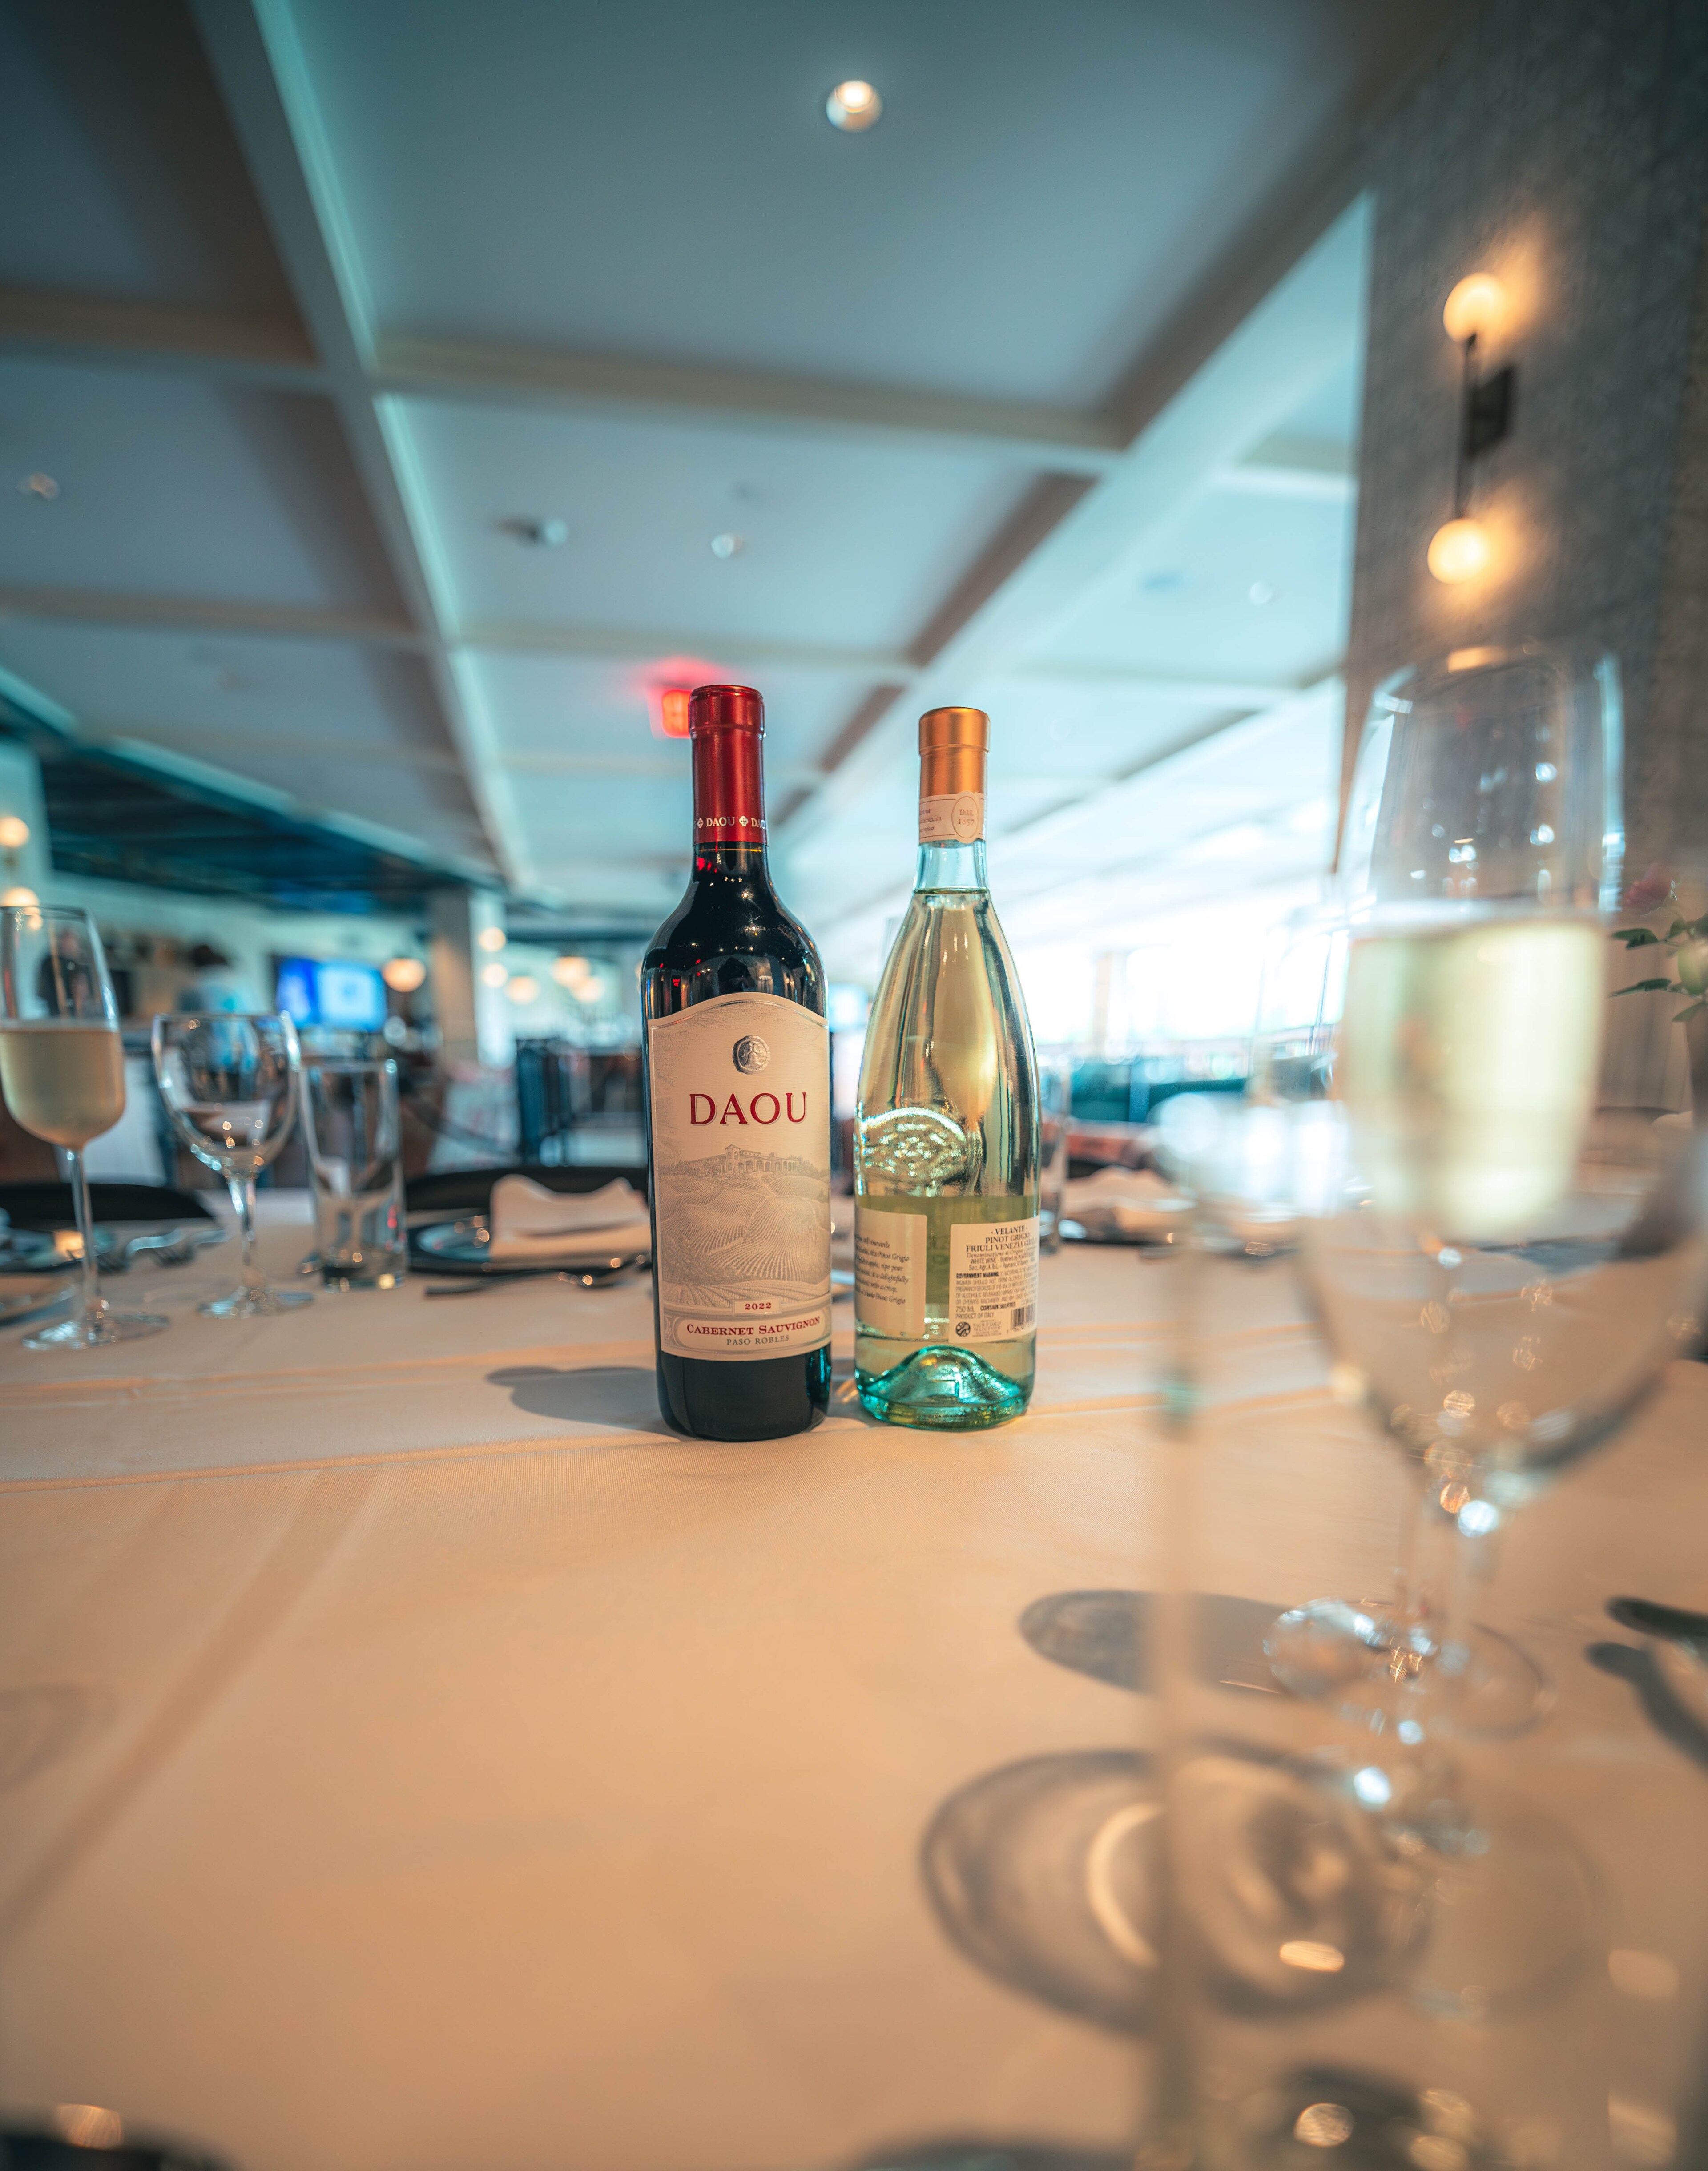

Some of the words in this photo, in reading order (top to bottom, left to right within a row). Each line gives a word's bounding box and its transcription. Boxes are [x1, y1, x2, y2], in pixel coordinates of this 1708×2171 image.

[706, 817, 735, 827] DAOU
[751, 818, 767, 829] DAO
[958, 818, 975, 827] 1857
[689, 1092, 807, 1126] DAOU
[995, 1225, 1025, 1235] VELANTE
[986, 1236, 1009, 1244] PINOT
[1011, 1232, 1031, 1241] GRIGIO
[995, 1242, 1023, 1250] VENEZIA
[891, 1253, 910, 1263] Grigio
[687, 1324, 754, 1335] CABERNET
[758, 1316, 820, 1334] SAUVIGNON
[755, 1335, 790, 1344] ROBLES
